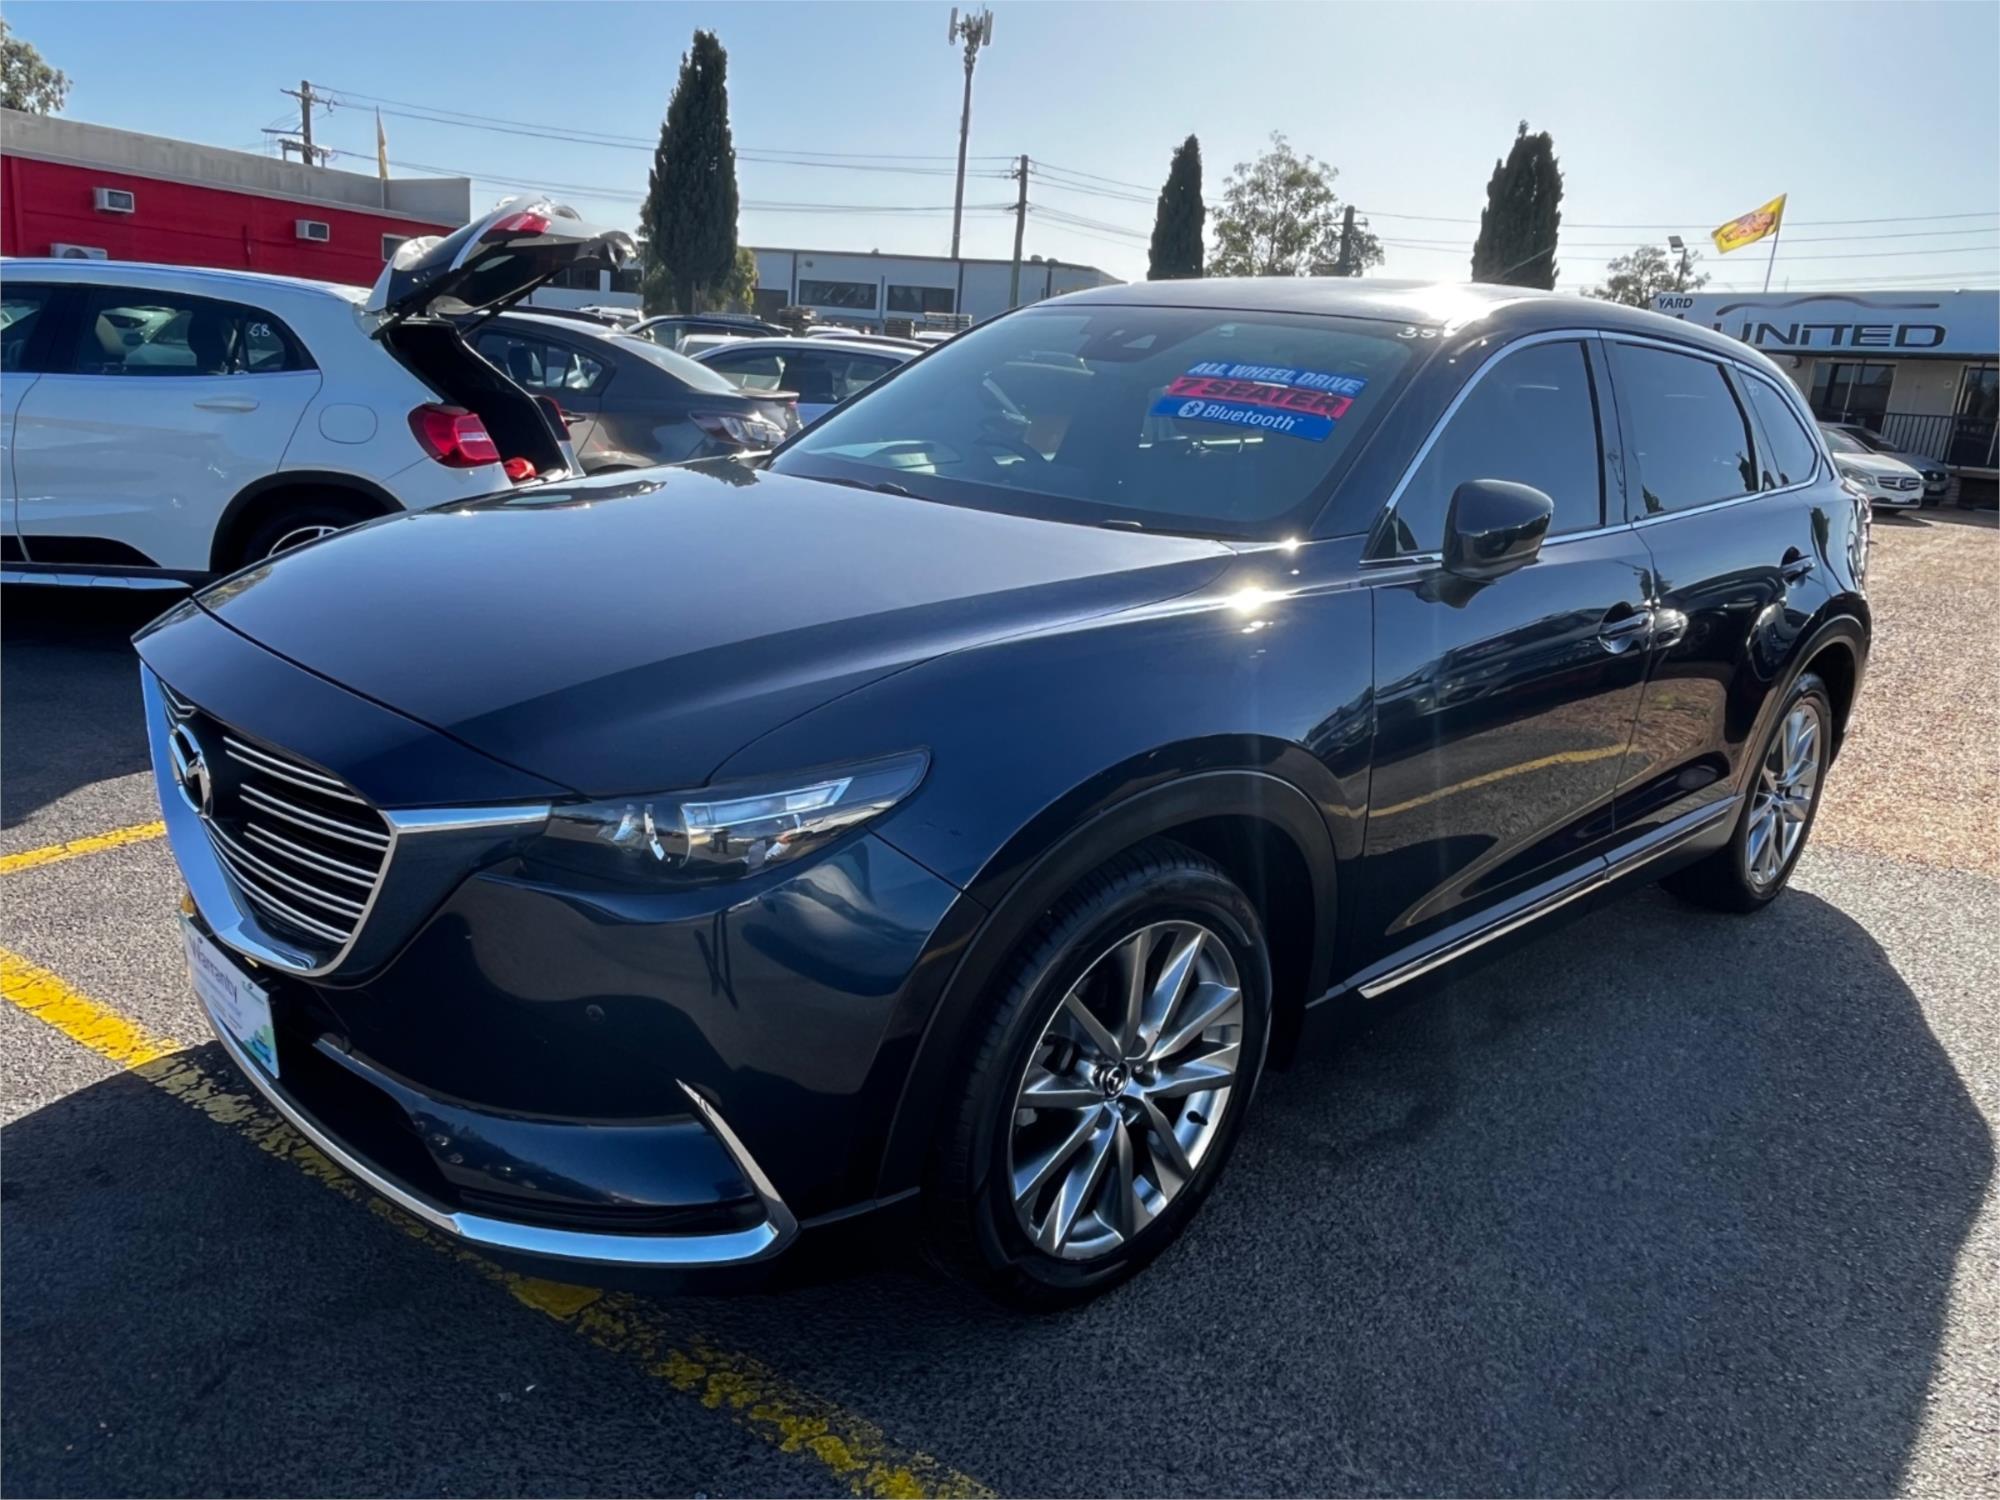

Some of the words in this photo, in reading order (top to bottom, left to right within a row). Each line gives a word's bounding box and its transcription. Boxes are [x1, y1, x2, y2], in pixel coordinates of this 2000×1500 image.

[1659, 298, 1693, 309] YARD
[1187, 362, 1226, 376] ALL
[1228, 364, 1296, 383] WHEEL
[1295, 372, 1366, 394] DRIVE
[1171, 379, 1204, 395] 7
[1201, 380, 1345, 414] SEATER
[1202, 404, 1296, 431] Bluetooth
